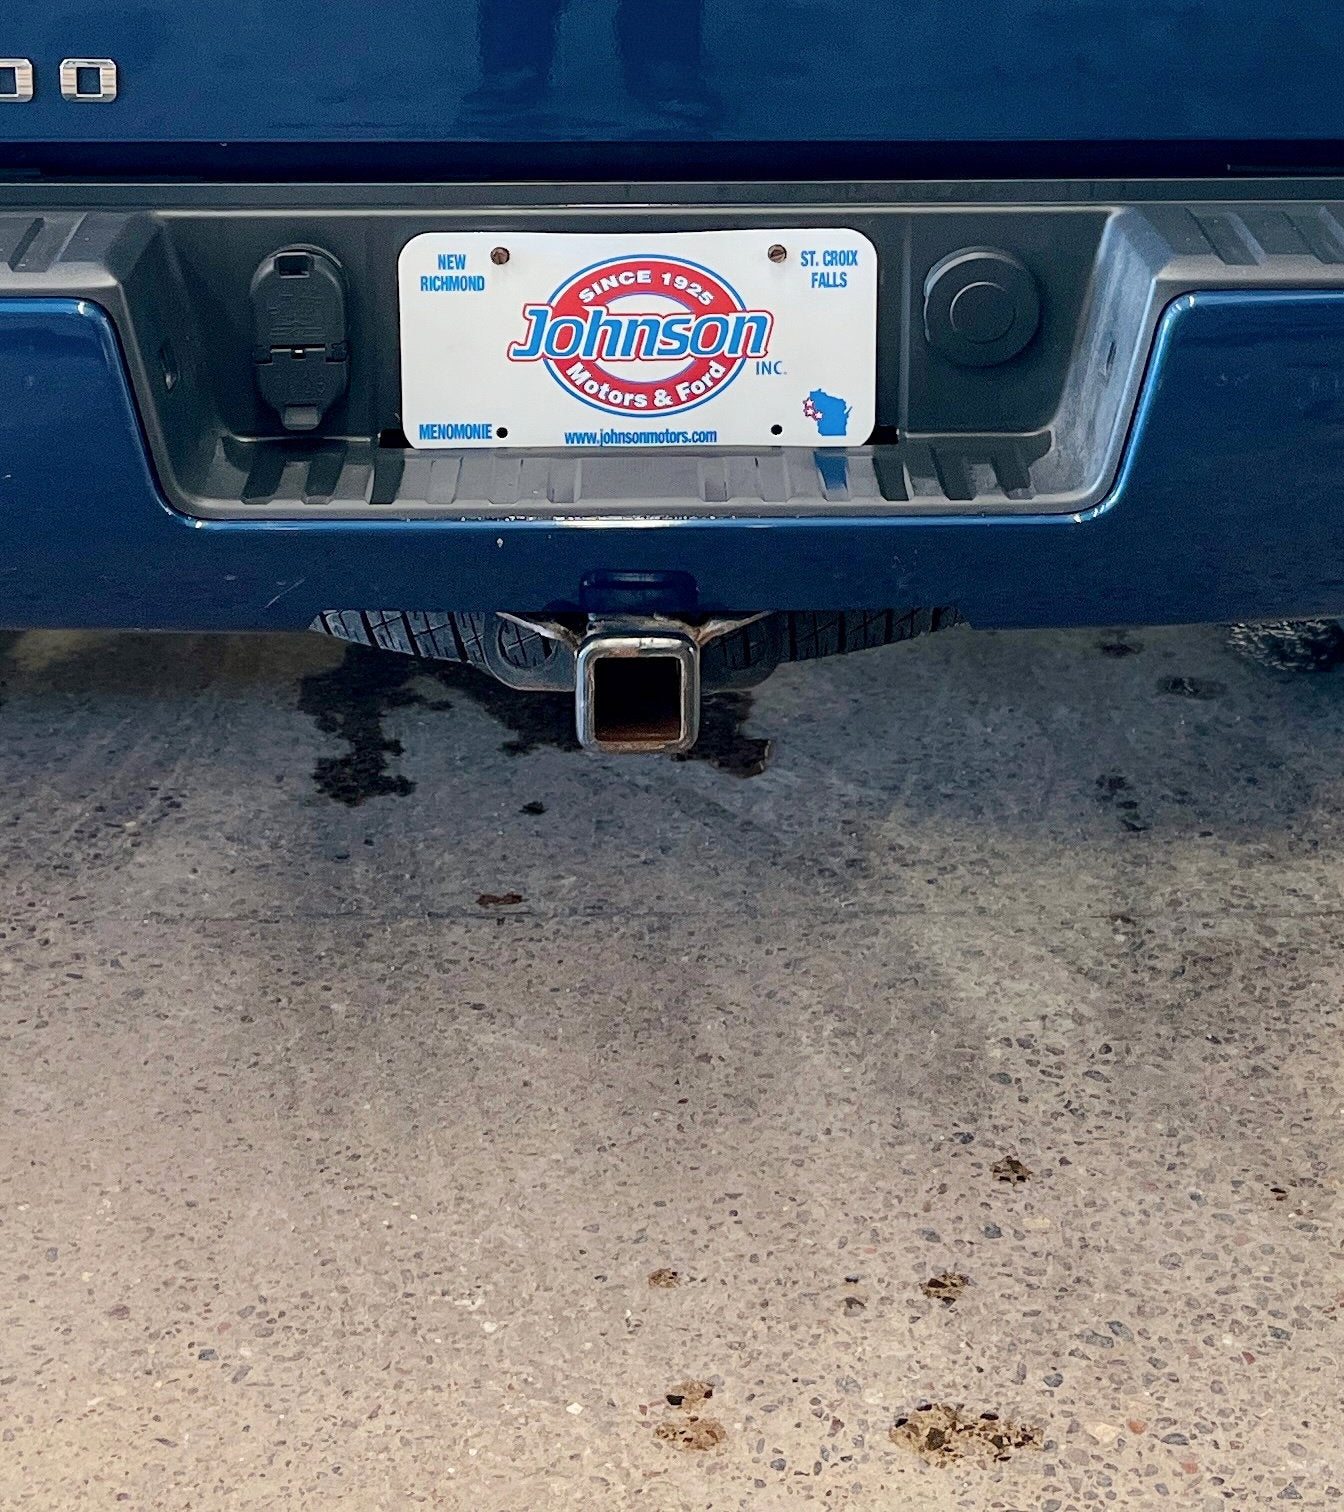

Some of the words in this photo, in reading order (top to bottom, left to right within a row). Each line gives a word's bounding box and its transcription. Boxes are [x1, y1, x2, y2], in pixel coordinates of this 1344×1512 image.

[437, 254, 466, 270] NEW
[800, 250, 819, 267] ST.
[822, 250, 858, 266] CROIX
[420, 275, 485, 291] RICHMOND
[578, 269, 652, 304] SINCE
[661, 272, 715, 306] 1925
[811, 272, 848, 288] FALLS
[510, 307, 770, 358] Johnson
[755, 360, 787, 376] INC.
[565, 361, 648, 408] Motors
[653, 389, 673, 407] &
[675, 360, 727, 402] Ford
[419, 423, 493, 440] MENOMONIE
[564, 429, 718, 447] www.johnsonmotors.com
